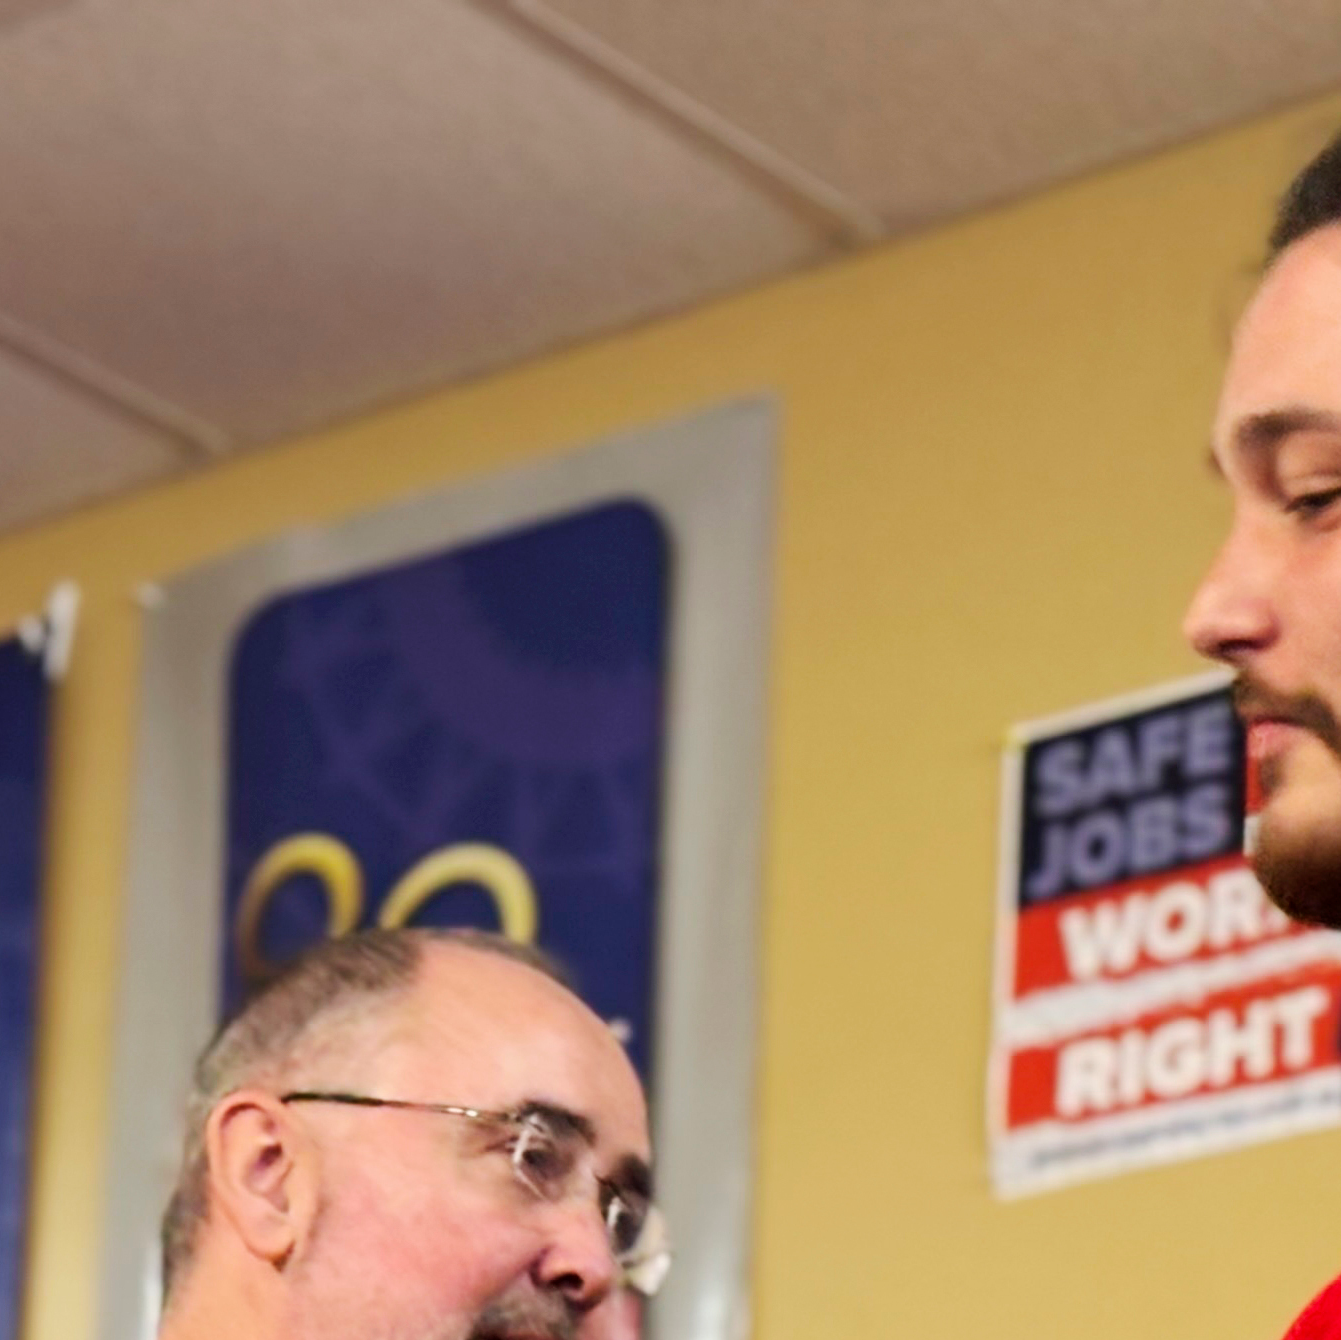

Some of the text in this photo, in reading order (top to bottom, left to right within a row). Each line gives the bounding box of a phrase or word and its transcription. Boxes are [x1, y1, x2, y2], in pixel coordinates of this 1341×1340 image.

[1033, 697, 1233, 815] SAFE
[1026, 781, 1235, 899] JOBS
[1054, 986, 1331, 1118] RIGHT
